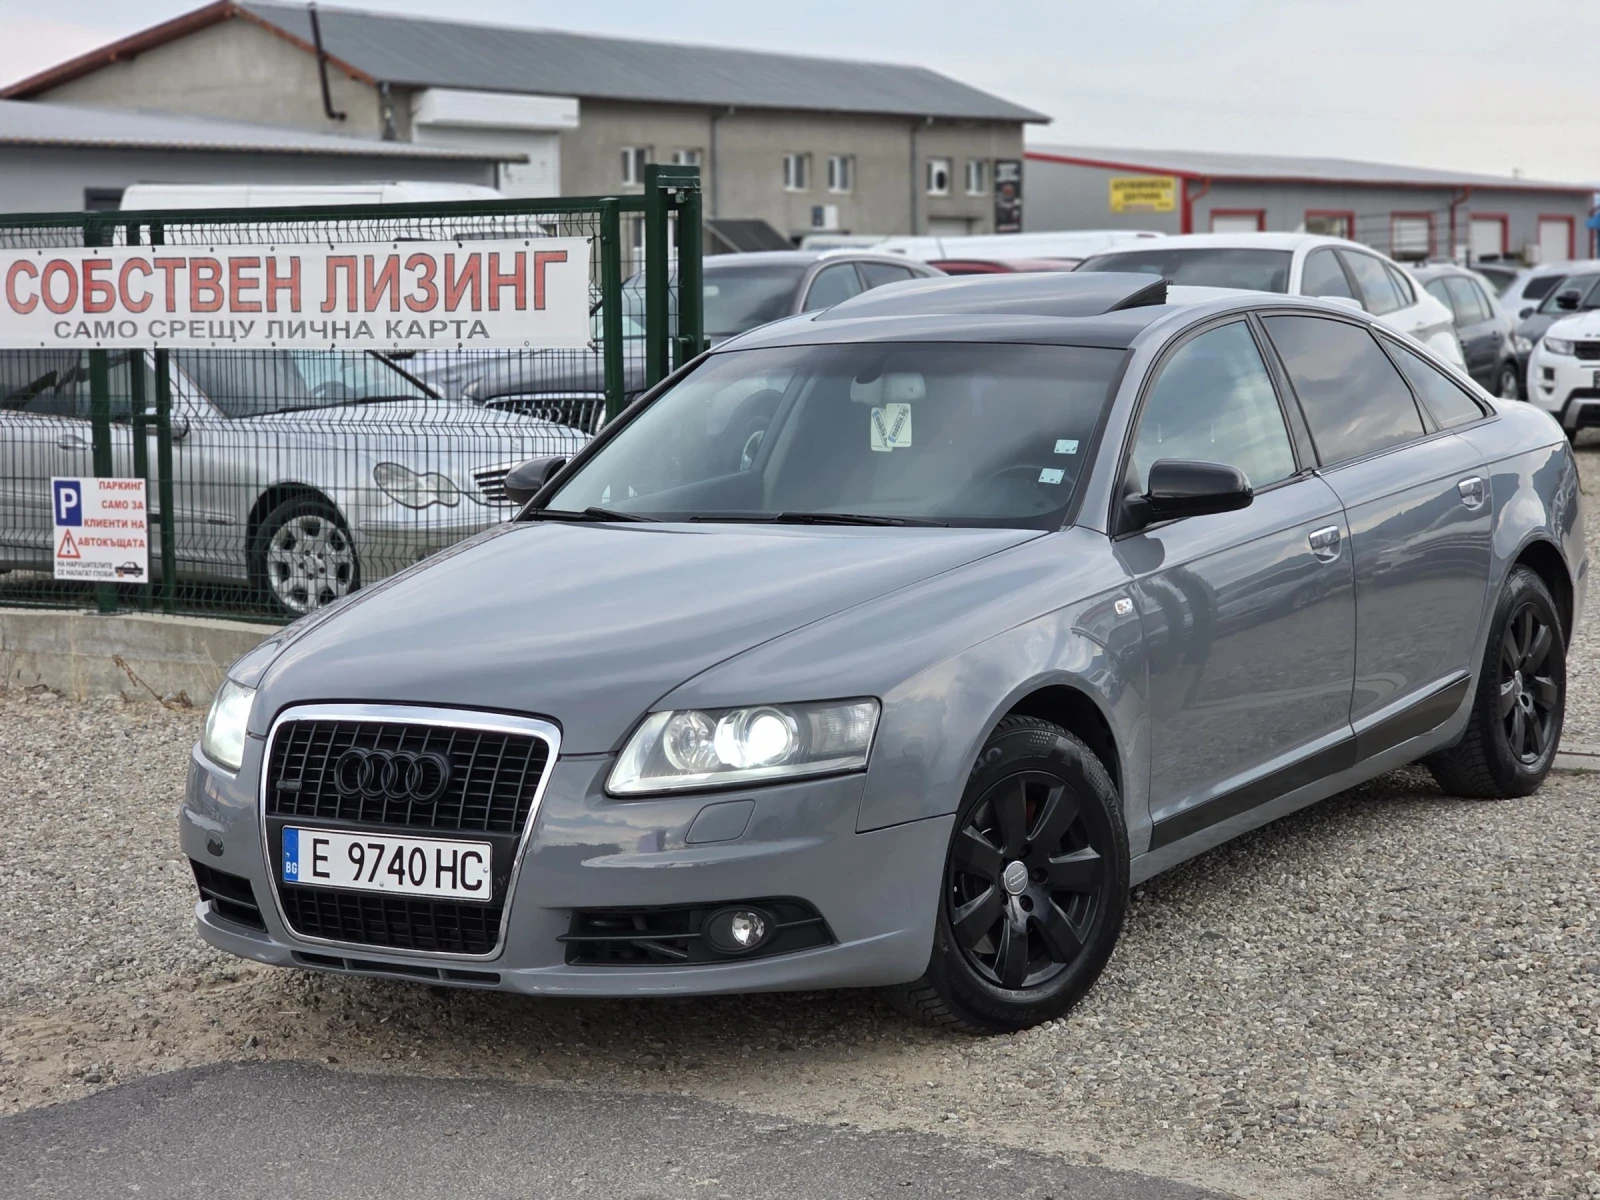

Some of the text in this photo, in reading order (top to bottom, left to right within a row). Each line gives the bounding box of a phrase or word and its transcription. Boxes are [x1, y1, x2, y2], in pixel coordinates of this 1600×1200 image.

[5, 250, 568, 314] СОБСТВЕН ЛИЗИНГ
[53, 318, 490, 342] САМО СРЕЩУ ЛИЧНА КАРТА
[99, 481, 143, 490] ПАРКИНГ
[60, 487, 78, 520] P
[101, 500, 144, 510] САМО ЗА
[84, 519, 145, 529] КЛИЕНТИ НА
[78, 537, 145, 549] АВТОКЪЩАТА
[285, 861, 298, 874] BG
[312, 838, 483, 891] E 9740 HC
